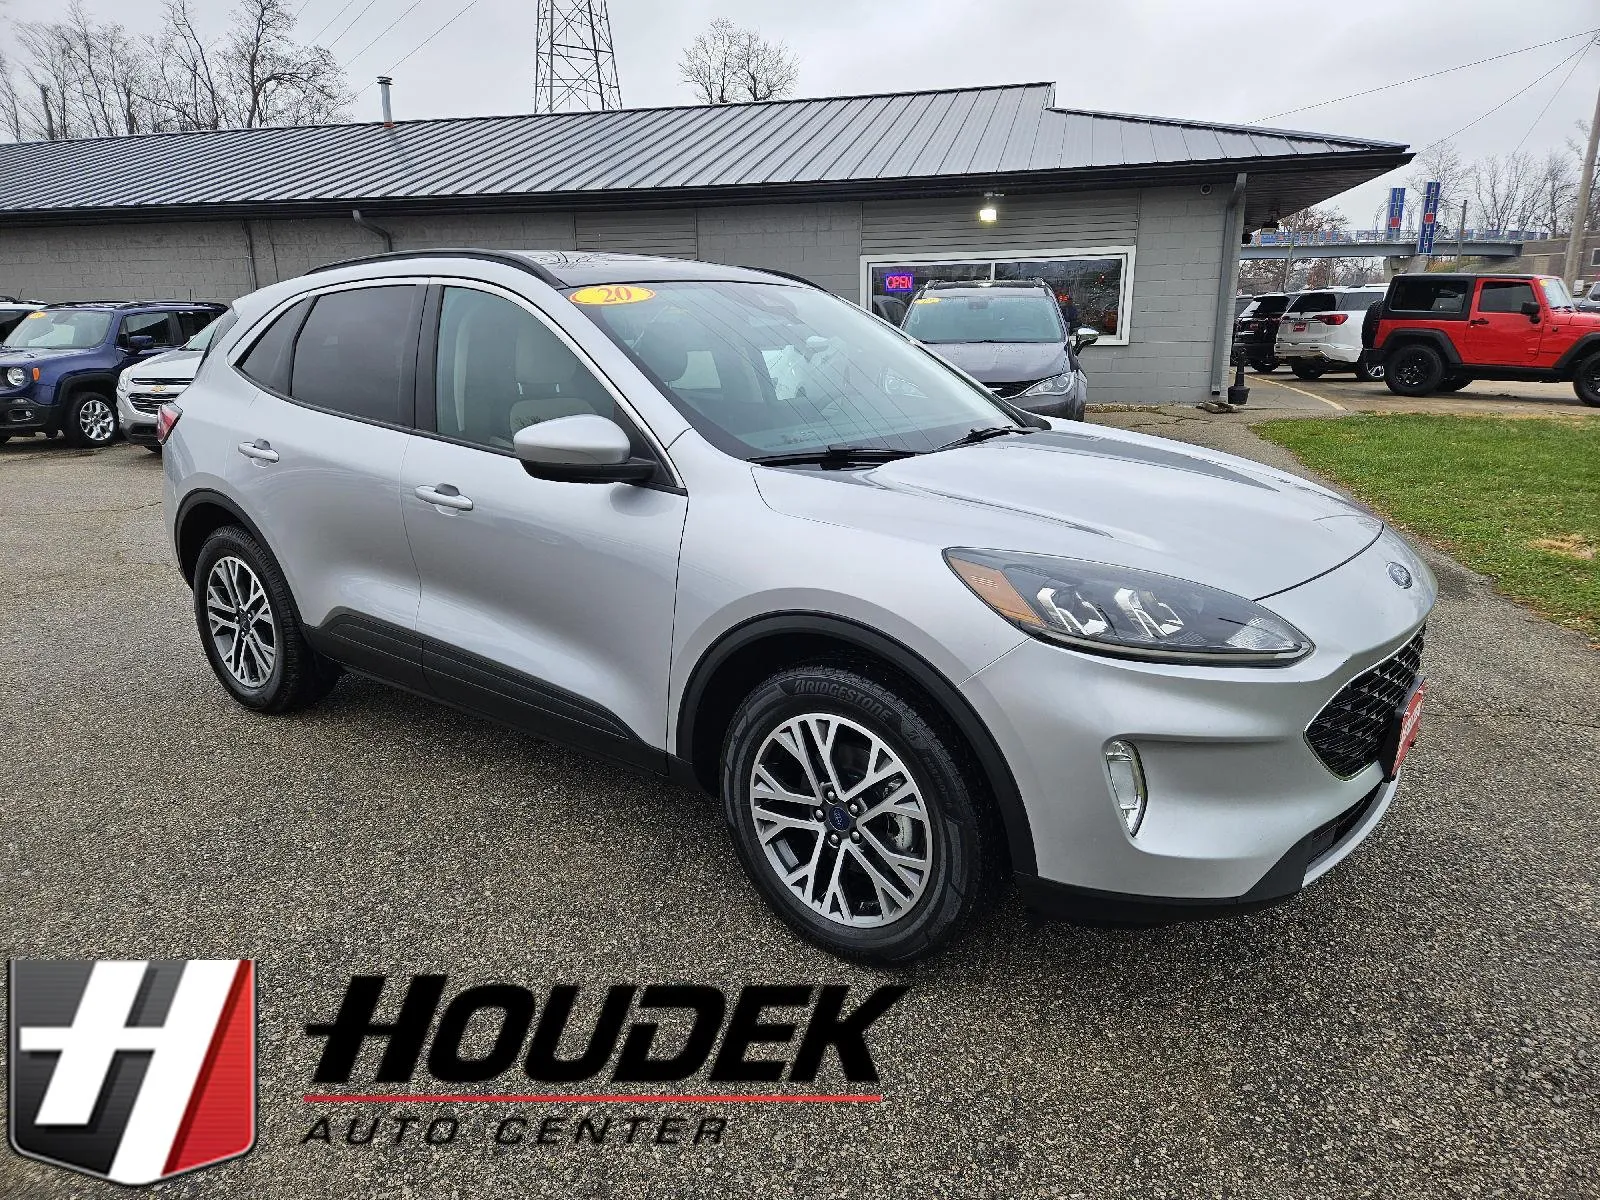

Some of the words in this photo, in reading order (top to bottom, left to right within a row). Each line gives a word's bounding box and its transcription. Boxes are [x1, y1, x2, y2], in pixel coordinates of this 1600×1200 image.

[887, 275, 912, 289] OPEN
[597, 286, 632, 303] 20
[795, 679, 893, 721] BRIDGESTONE
